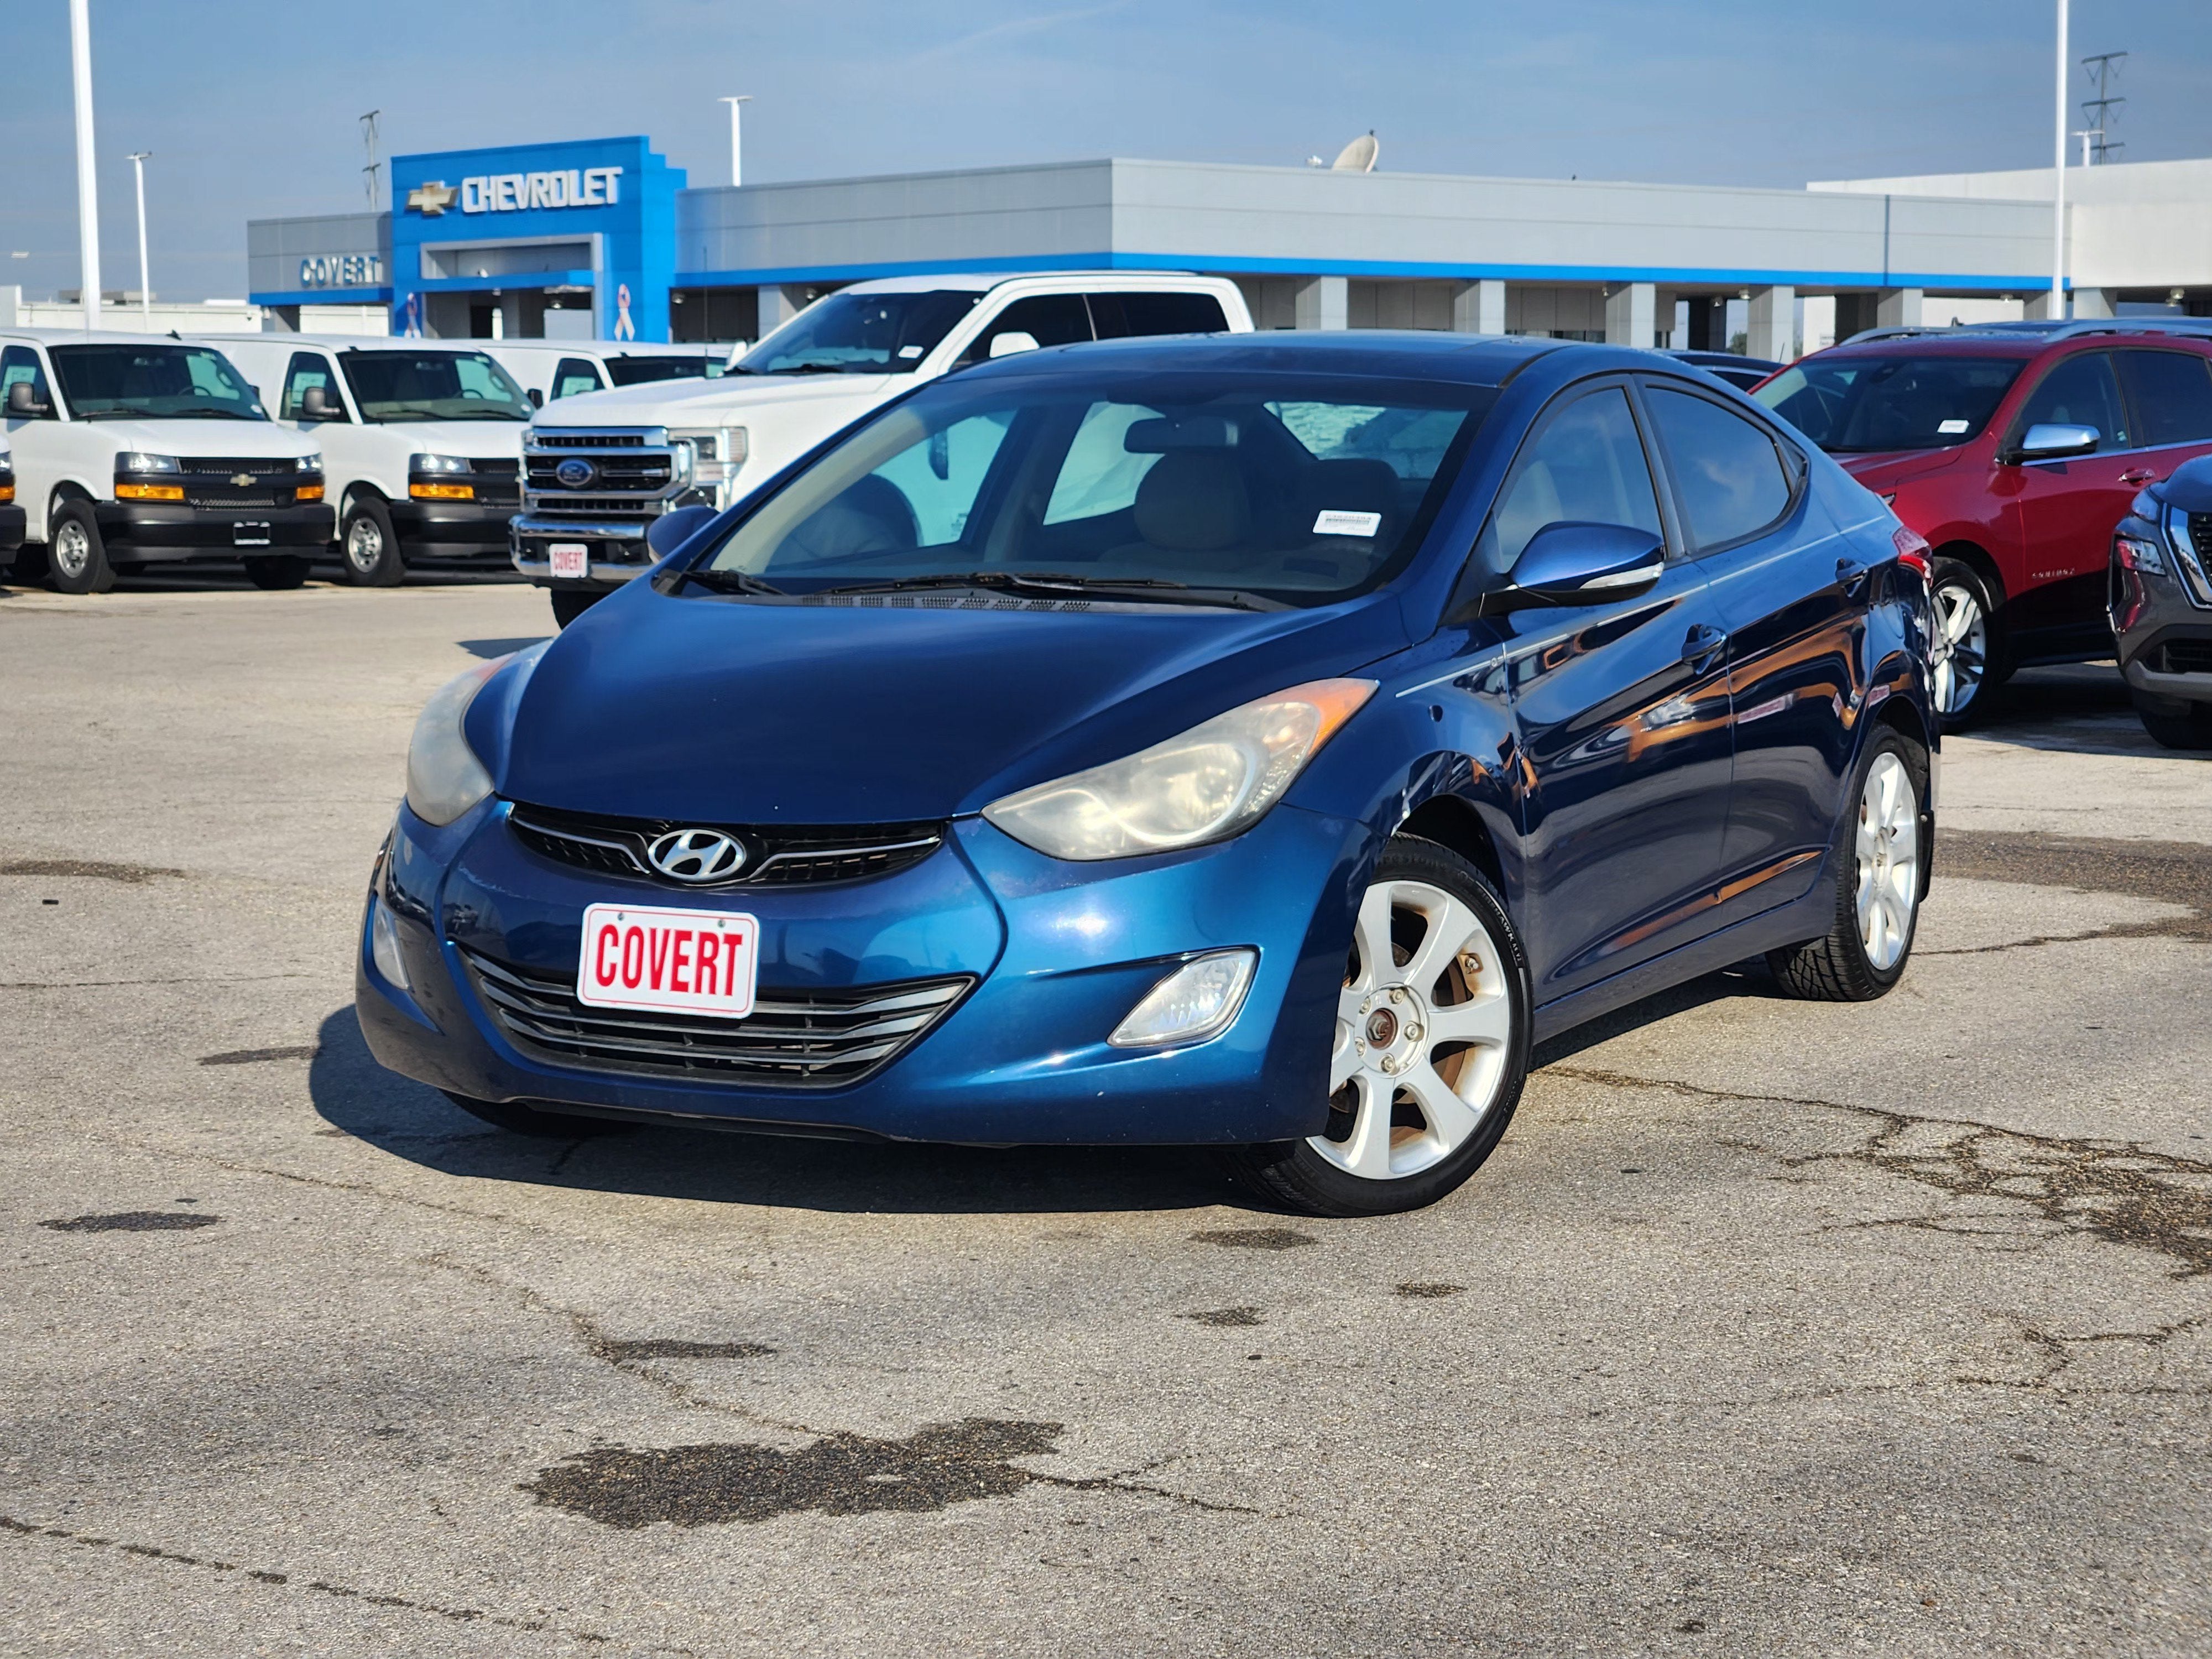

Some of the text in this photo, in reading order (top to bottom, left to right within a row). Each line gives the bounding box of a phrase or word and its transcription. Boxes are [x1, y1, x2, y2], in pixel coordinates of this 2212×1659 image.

[462, 166, 623, 213] CHEVROLET
[300, 257, 382, 286] COVERT
[554, 551, 582, 570] COVERT
[595, 924, 743, 997] COVERT
